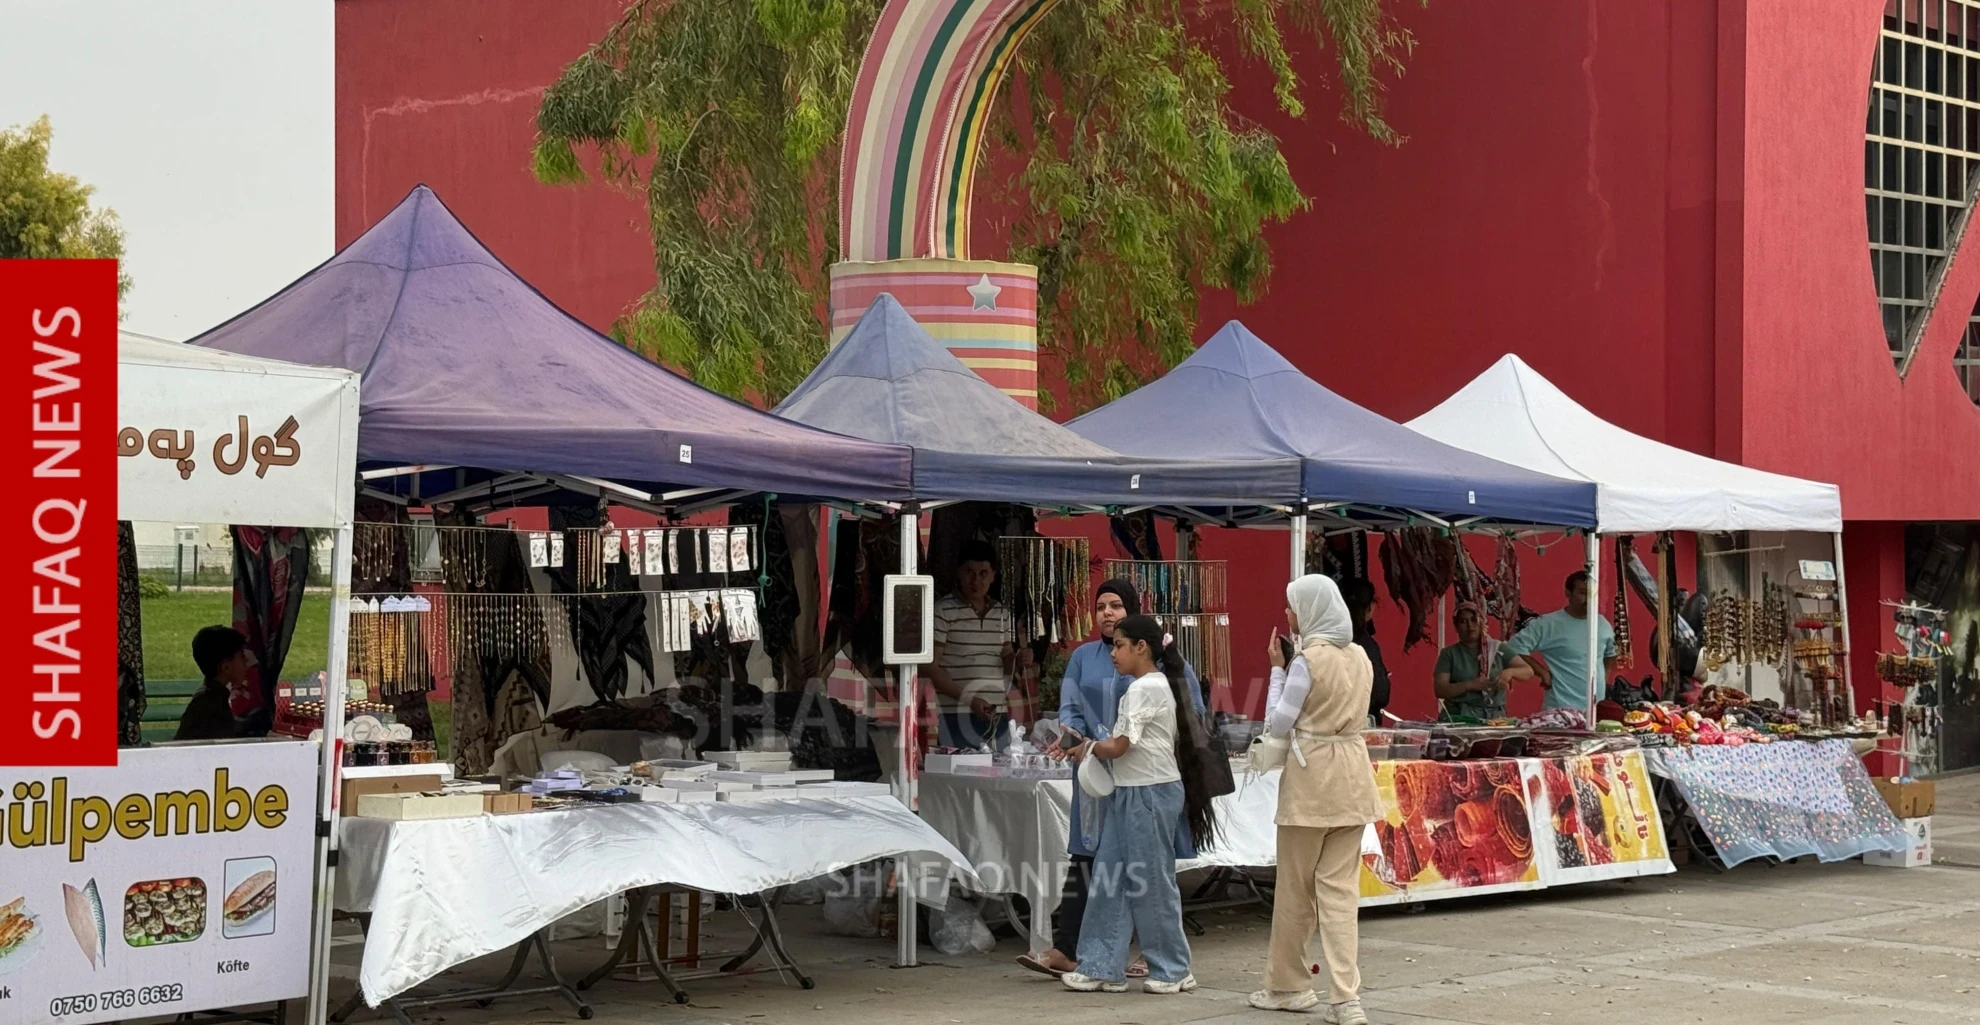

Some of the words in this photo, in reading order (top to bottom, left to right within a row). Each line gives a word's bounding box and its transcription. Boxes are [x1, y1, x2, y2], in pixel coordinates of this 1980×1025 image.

[118, 427, 195, 480] پەم
[213, 415, 300, 479] گول
[681, 449, 690, 459] 25
[0, 768, 288, 862] ülpembe
[217, 959, 250, 975] Köfte
[51, 994, 97, 1016] 0750
[101, 989, 135, 1010] 766
[139, 983, 183, 1005] 6632
